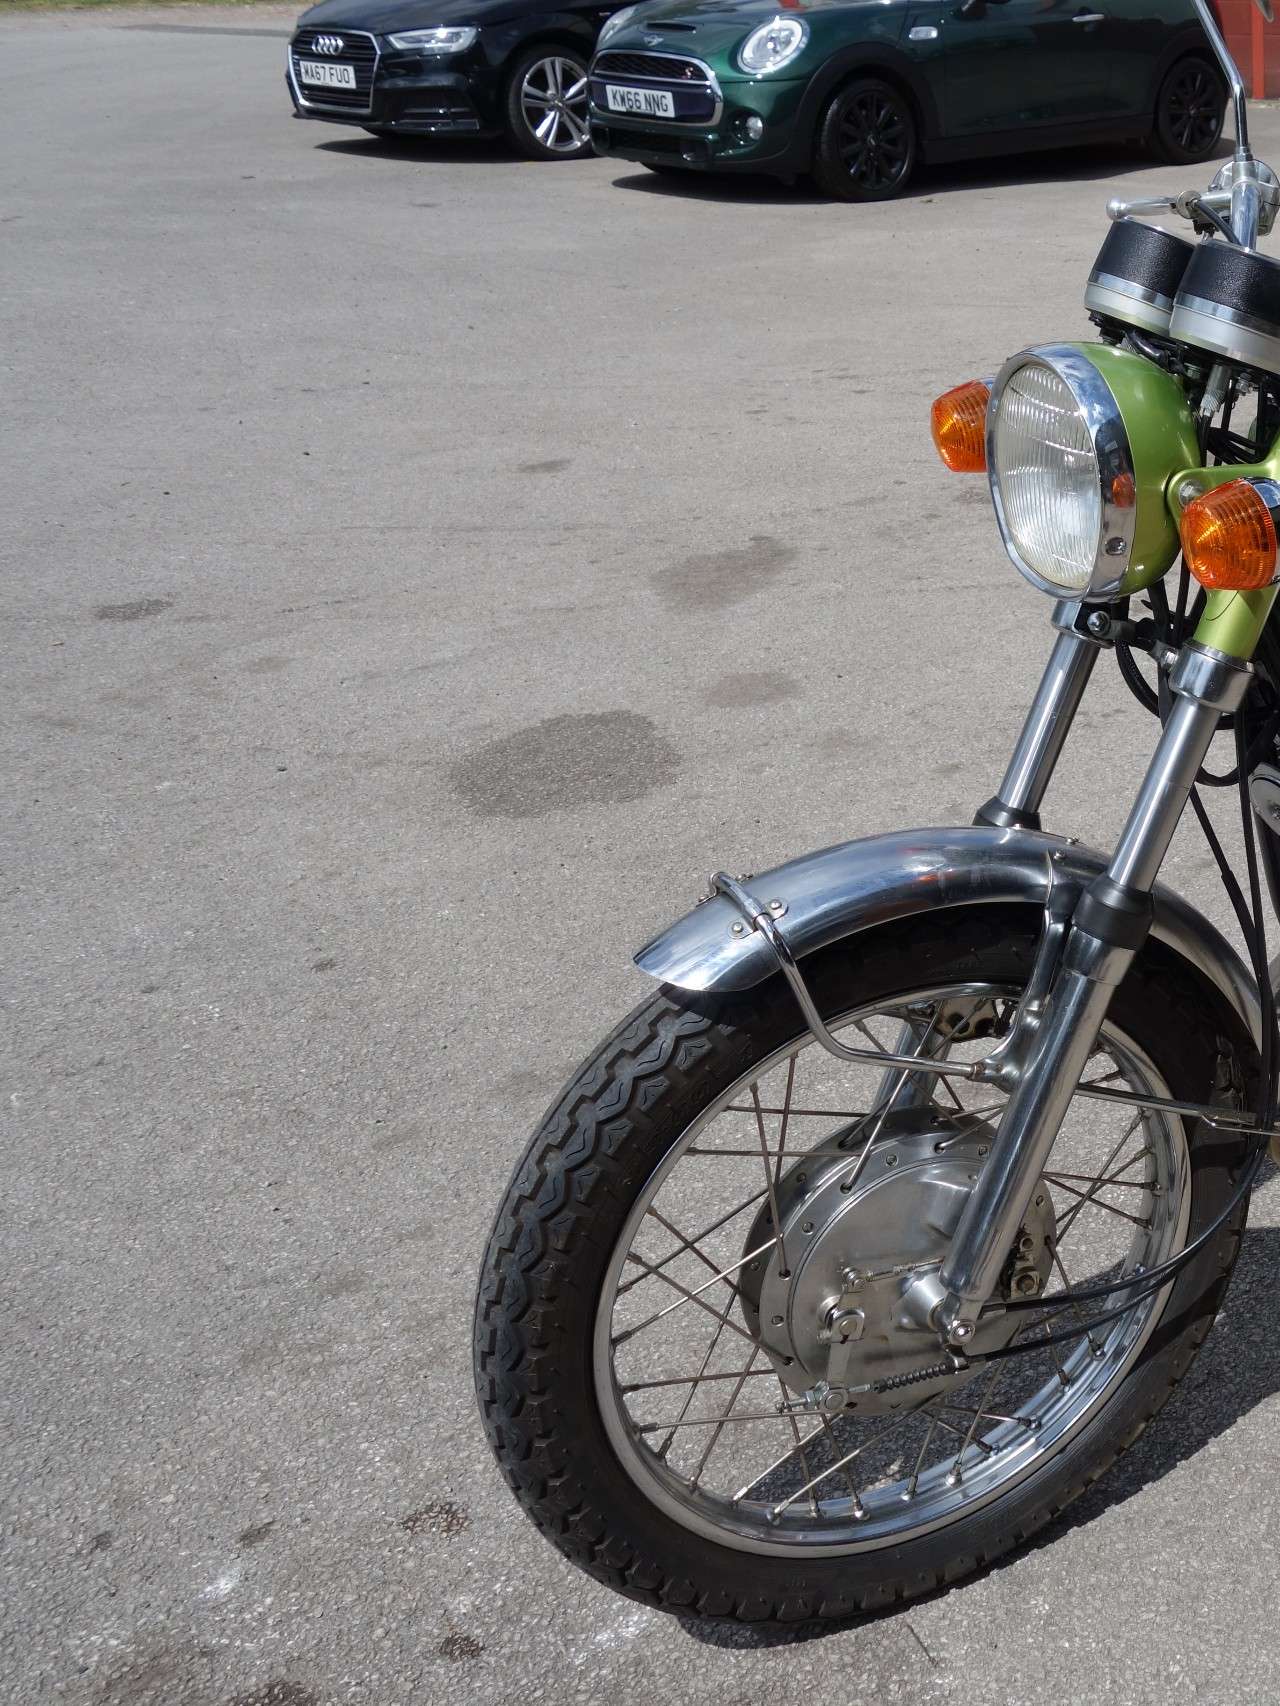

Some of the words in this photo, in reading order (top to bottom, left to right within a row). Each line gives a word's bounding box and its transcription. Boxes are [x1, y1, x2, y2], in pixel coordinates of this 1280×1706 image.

[303, 63, 327, 81] MA67
[611, 89, 642, 109] KW66
[643, 93, 669, 113] NNG
